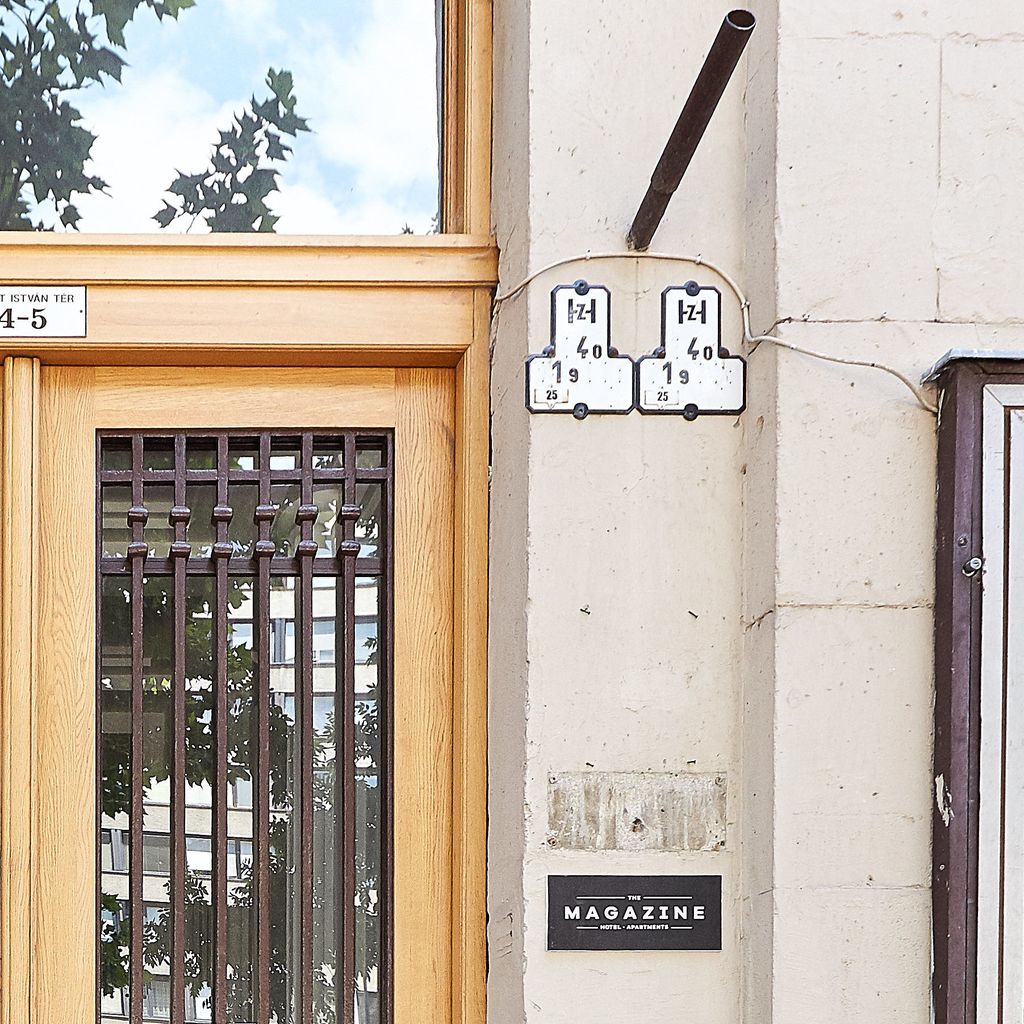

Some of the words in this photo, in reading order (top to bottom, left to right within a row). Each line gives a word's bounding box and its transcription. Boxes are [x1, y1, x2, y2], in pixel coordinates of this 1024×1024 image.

[10, 291, 49, 303] ISTVÁN
[53, 291, 75, 303] TÉR
[546, 390, 558, 401] 25
[657, 391, 669, 402] 25
[564, 905, 706, 920] MAGAZINE
